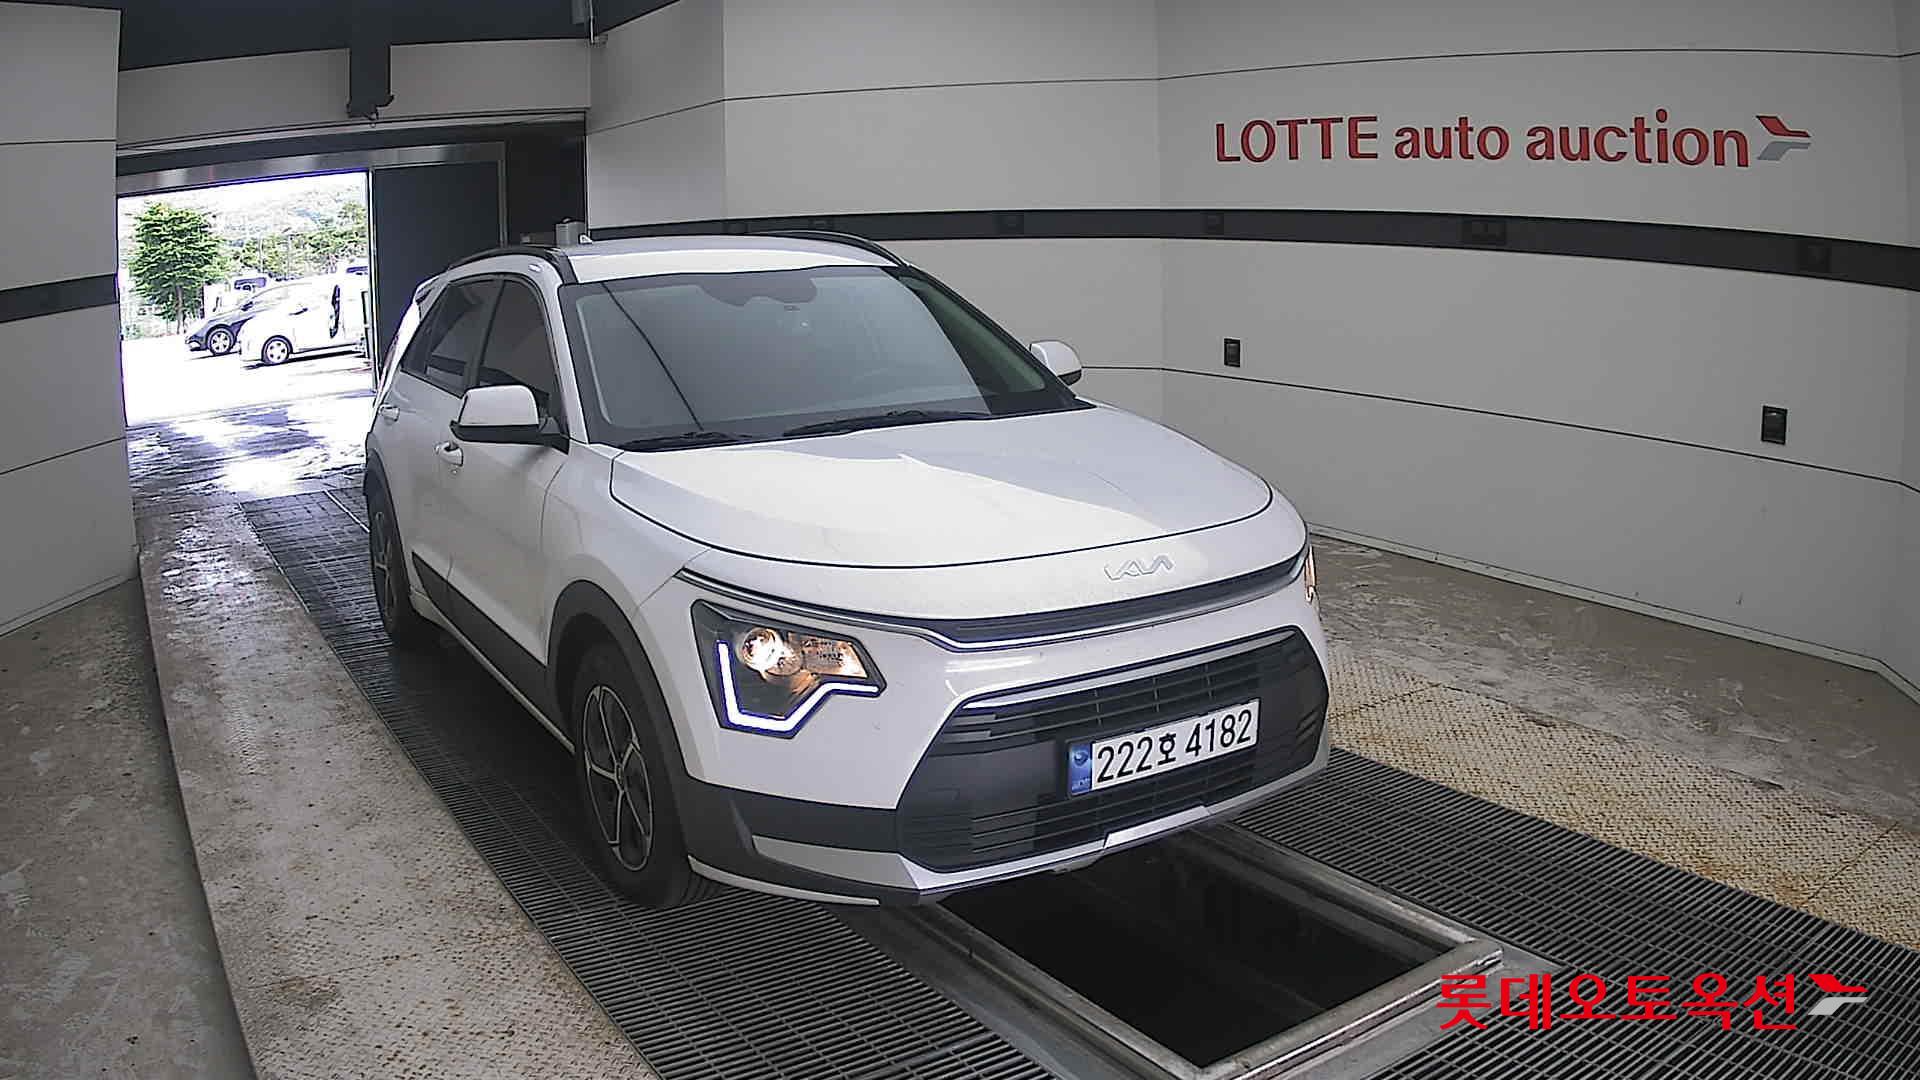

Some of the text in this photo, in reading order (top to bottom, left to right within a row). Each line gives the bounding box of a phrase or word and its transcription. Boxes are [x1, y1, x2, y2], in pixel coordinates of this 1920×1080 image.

[1215, 108, 1749, 167] LOTTE auto auction
[1097, 709, 1252, 783] 222호 4182
